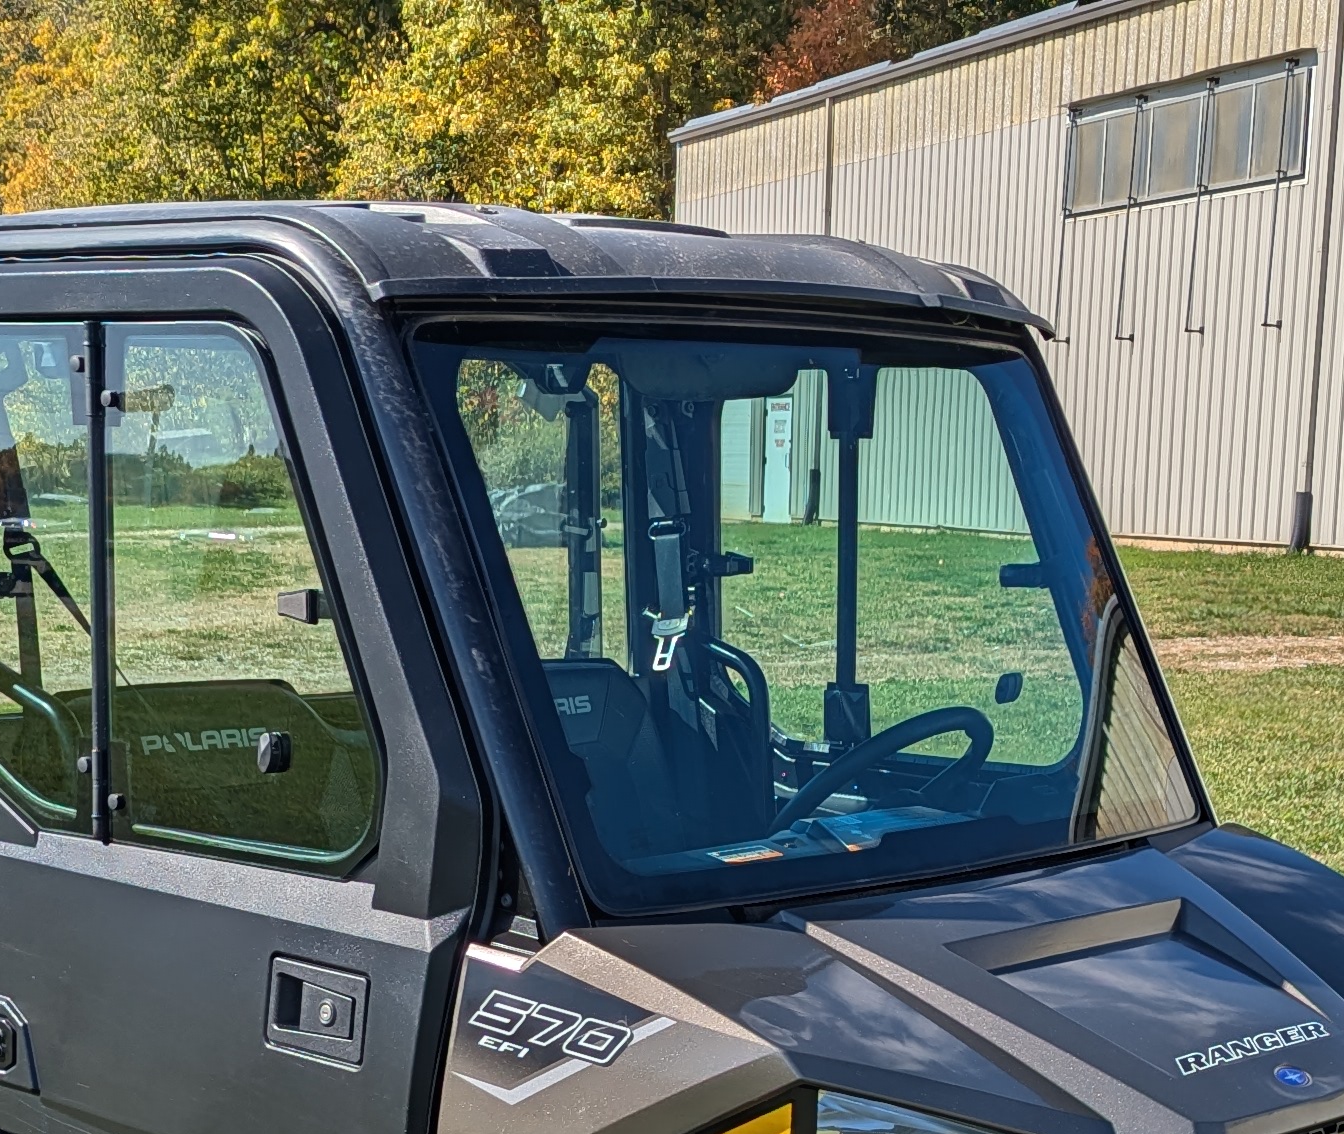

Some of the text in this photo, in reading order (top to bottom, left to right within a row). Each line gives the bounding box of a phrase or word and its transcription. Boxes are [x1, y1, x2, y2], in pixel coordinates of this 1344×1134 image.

[468, 989, 635, 1066] 570
[478, 1034, 530, 1058] EFI
[1174, 1020, 1331, 1076] RANGER
